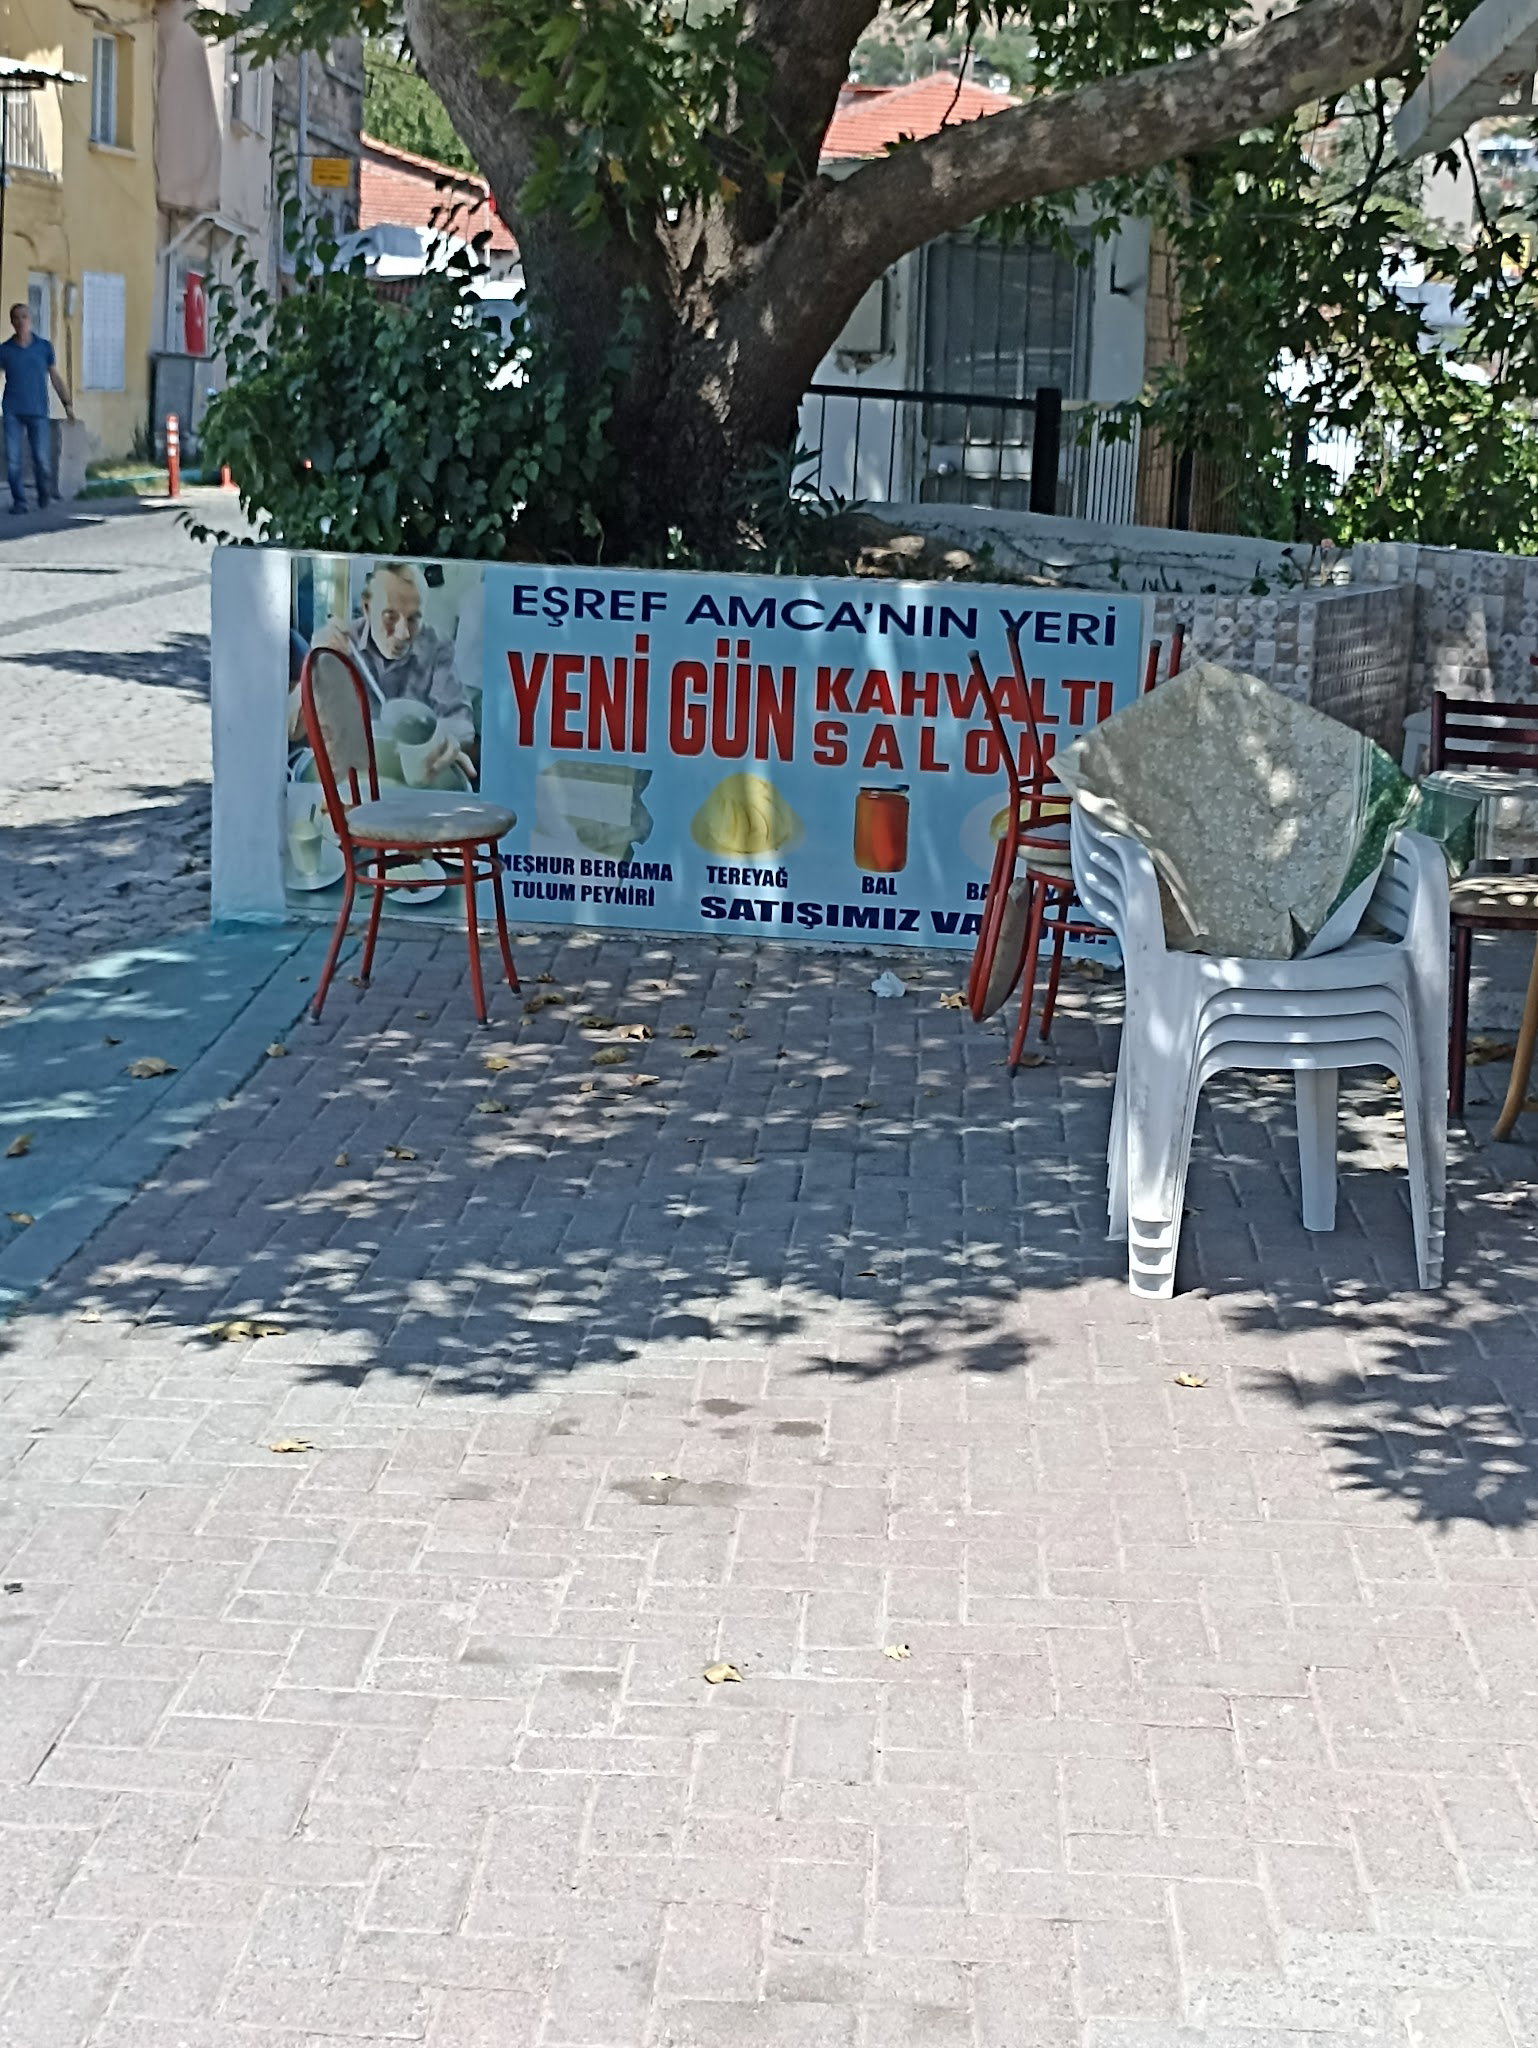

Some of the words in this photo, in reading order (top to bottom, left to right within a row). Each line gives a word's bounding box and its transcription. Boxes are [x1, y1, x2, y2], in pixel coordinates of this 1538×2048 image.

[513, 584, 668, 627] EŞREF
[685, 594, 979, 639] AMCA'NIN
[999, 606, 1116, 647] YERİ
[506, 633, 650, 754] YENİ
[669, 638, 797, 762] GÜN
[815, 666, 1114, 726] KAHVALTI
[813, 720, 1082, 777] SALON
[580, 859, 673, 882] BERGAMA
[706, 865, 789, 888] TEREYAĞ
[861, 876, 898, 896] BAL
[511, 880, 576, 901] TULUM
[580, 884, 655, 907] PEYNİRİ
[700, 896, 920, 932] SATIŞIMIZ
